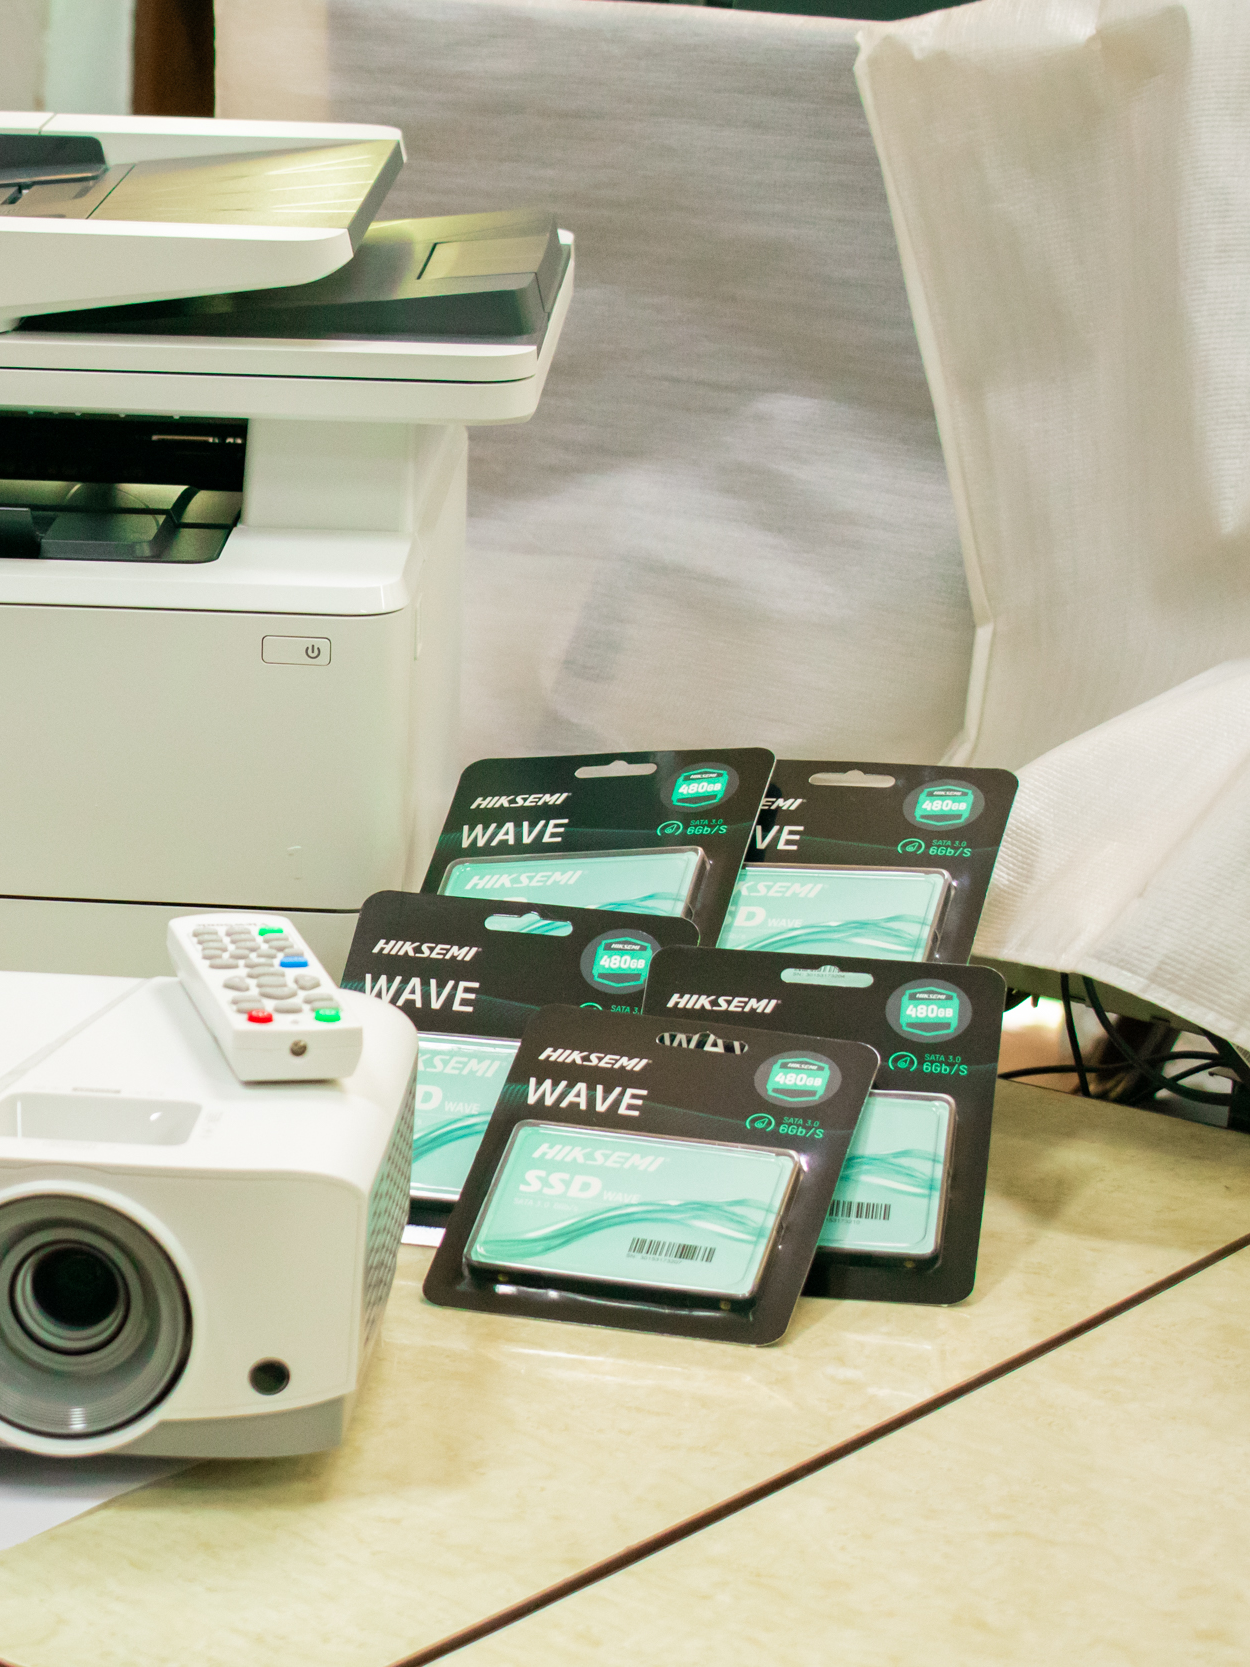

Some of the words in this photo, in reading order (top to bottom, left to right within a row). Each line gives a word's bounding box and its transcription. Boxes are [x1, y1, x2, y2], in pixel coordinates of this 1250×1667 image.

[678, 782, 722, 794] 480GB
[470, 793, 568, 810] HIKSEMI
[922, 800, 967, 811] 480GB
[461, 819, 569, 849] WAVE
[686, 825, 728, 835] 6Gb/S
[928, 846, 972, 857] 6Gb/S
[464, 870, 583, 890] HIKSEMI
[767, 918, 803, 928] WAVE
[372, 939, 478, 962] HIKSEMI
[600, 955, 646, 969] 480GB
[365, 974, 480, 1013] WAVE
[610, 1005, 630, 1014] SATA
[666, 993, 779, 1014] HIKSEMI
[906, 1004, 953, 1018] 480GB
[538, 1047, 649, 1072] HIKSEMI
[922, 1062, 968, 1076] 6Gb/S
[774, 1072, 822, 1086] 480GB
[526, 1077, 648, 1116] WAVE
[444, 1101, 481, 1114] WAVE
[783, 1116, 803, 1125] SATA
[779, 1124, 824, 1138] 6Gb/S
[532, 1143, 665, 1172] HIKSEMI
[519, 1169, 602, 1199] SSD
[603, 1190, 641, 1203] WAVE
